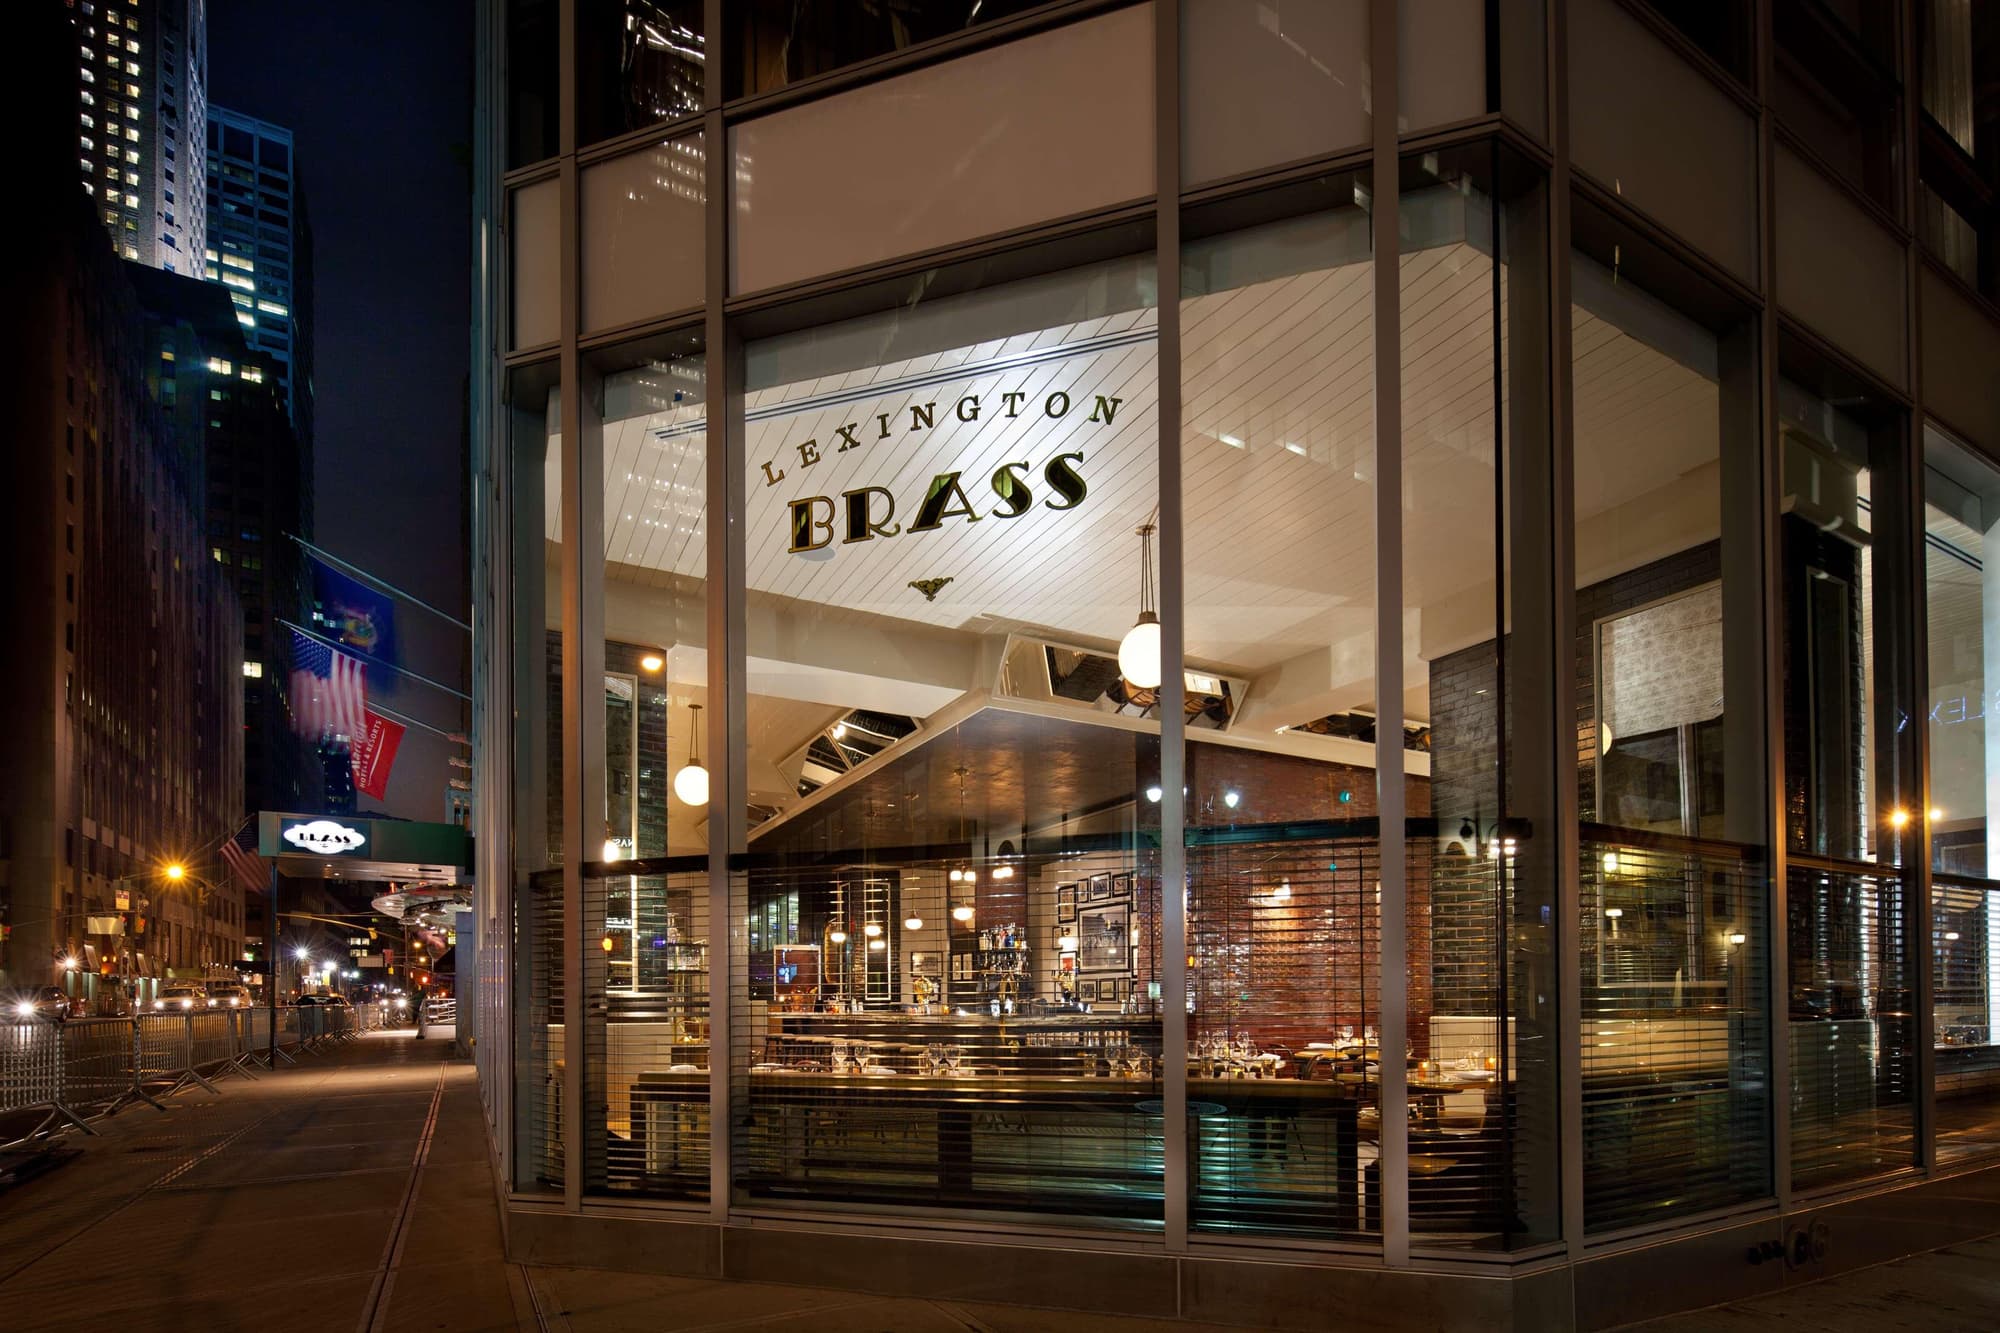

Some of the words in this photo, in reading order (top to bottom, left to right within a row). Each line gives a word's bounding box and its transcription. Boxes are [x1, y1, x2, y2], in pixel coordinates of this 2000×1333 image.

[761, 391, 1123, 487] LEXINGTON
[787, 451, 1088, 554] BRASS
[366, 719, 382, 753] RESORTS
